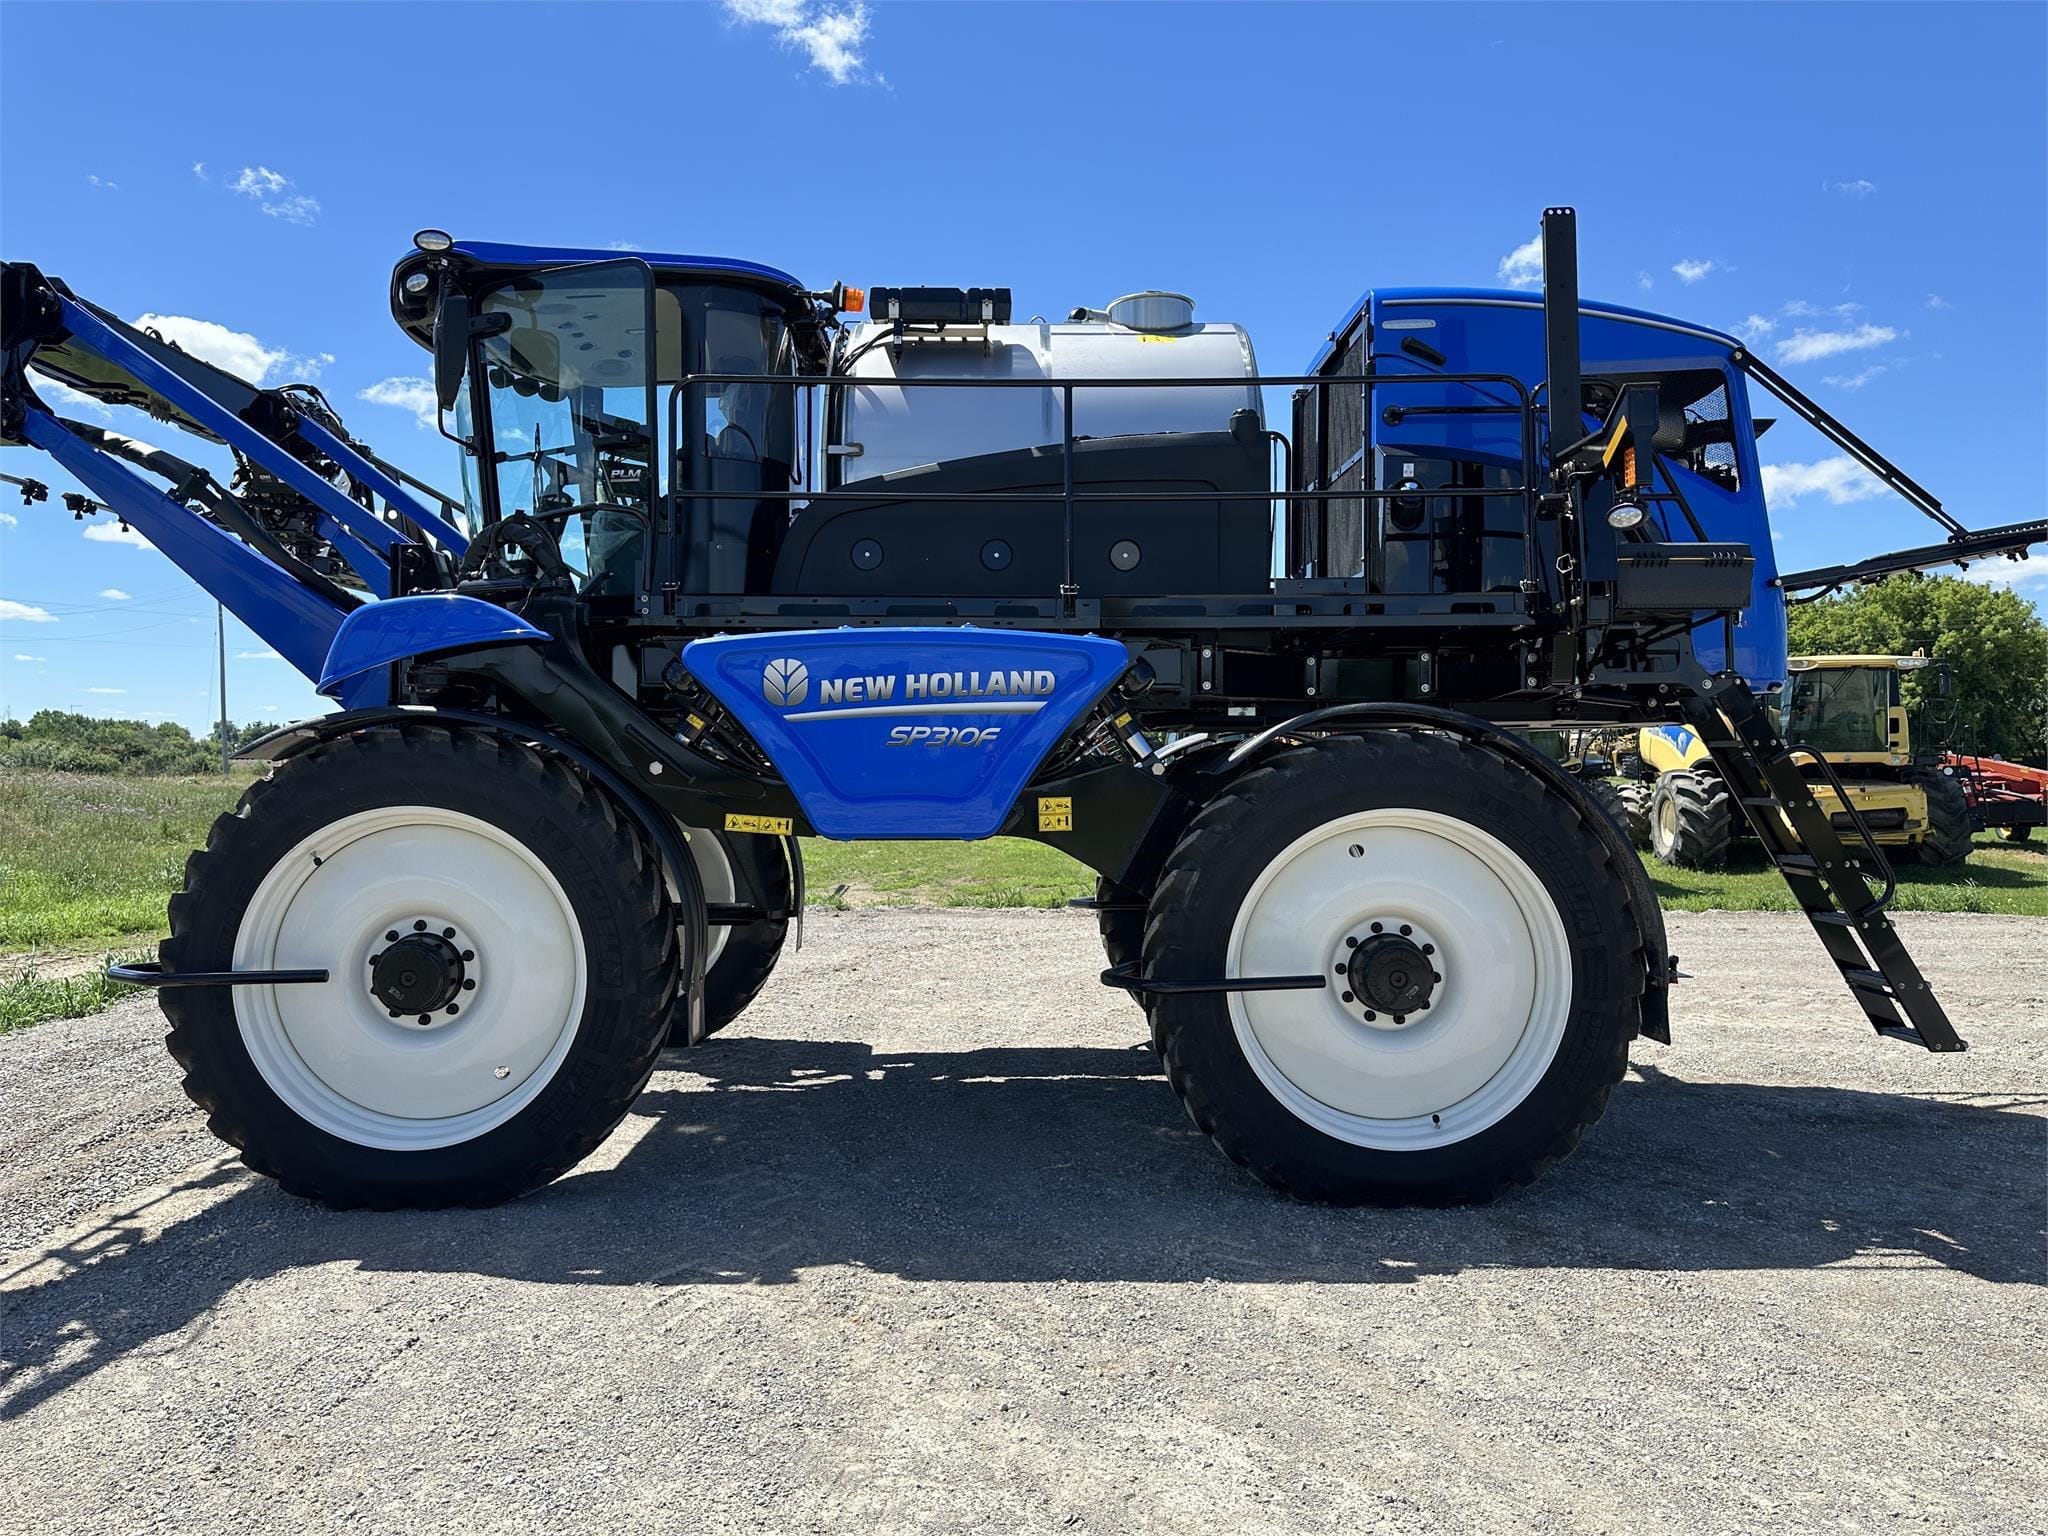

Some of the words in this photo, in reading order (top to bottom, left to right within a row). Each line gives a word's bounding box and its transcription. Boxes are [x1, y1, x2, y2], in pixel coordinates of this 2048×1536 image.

[610, 469, 641, 478] PLM
[820, 675, 896, 704] NEW
[905, 671, 1056, 698] HOLLAND
[886, 726, 1001, 748] SP310F
[555, 842, 621, 986] MICHELIN
